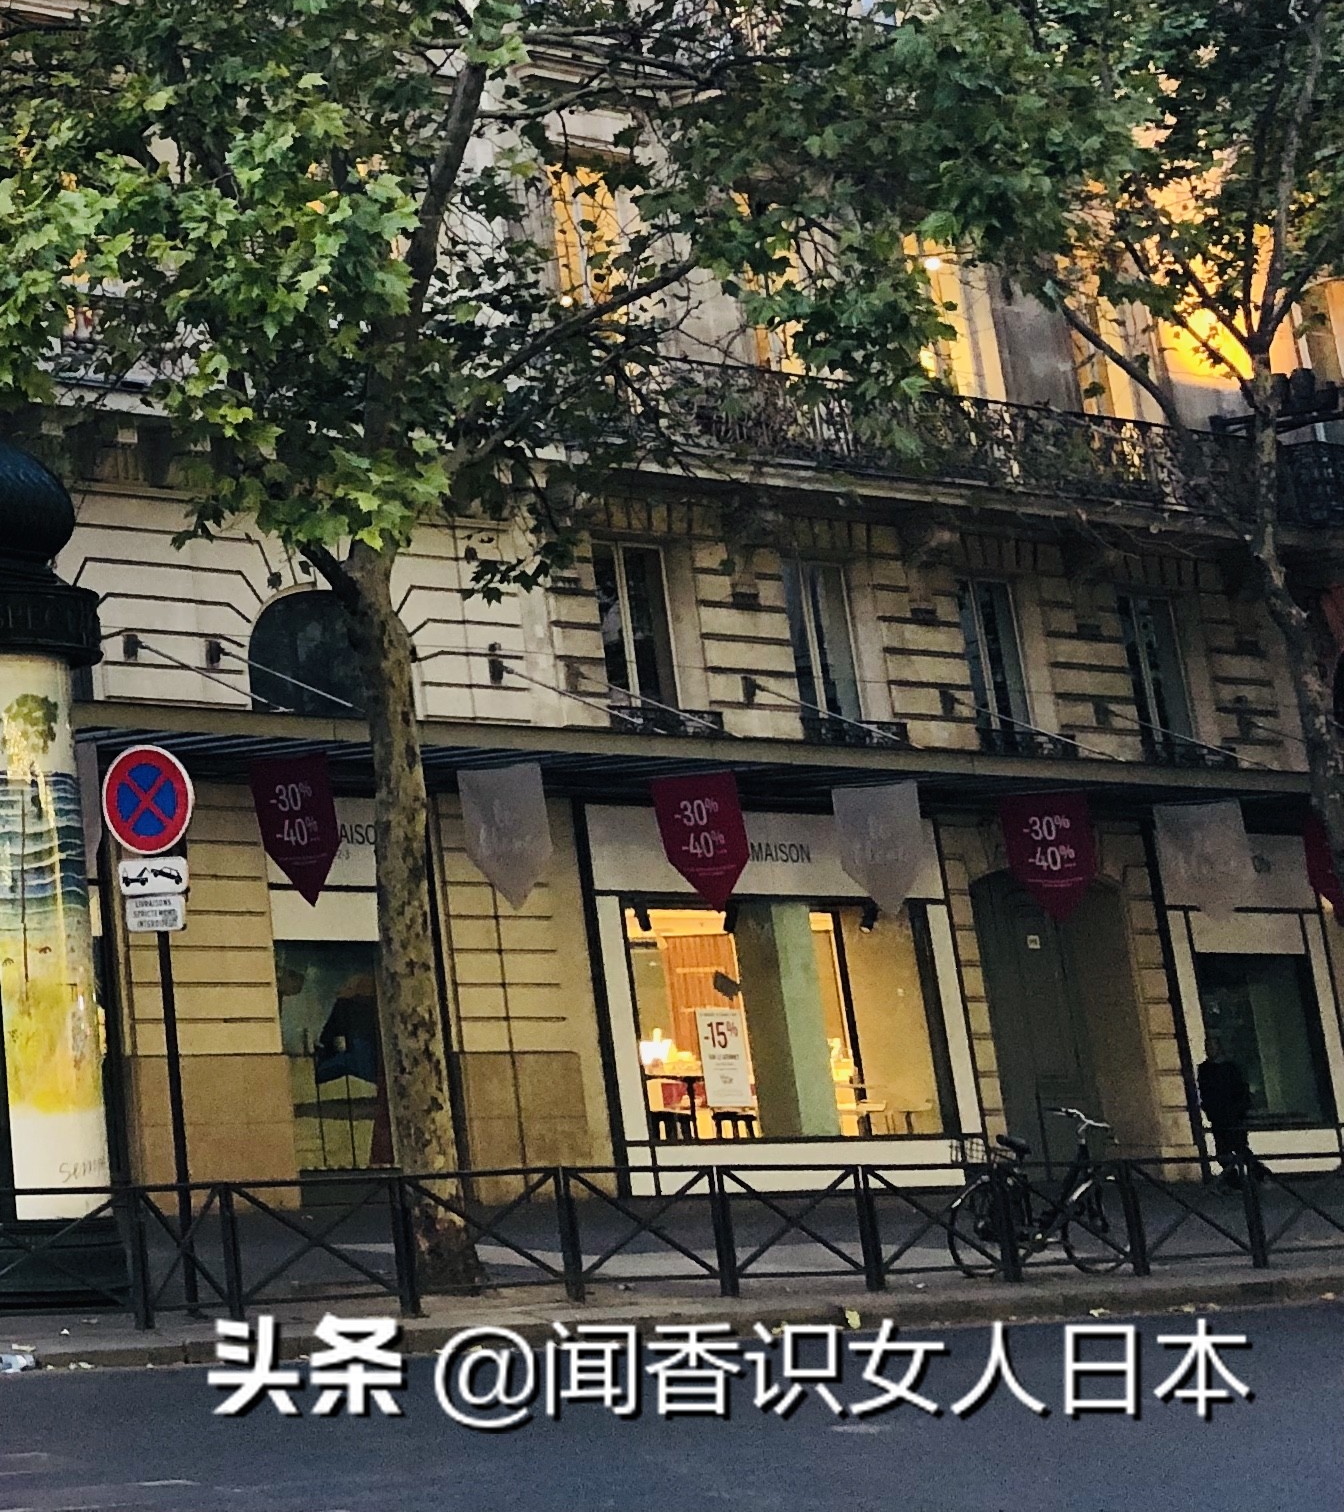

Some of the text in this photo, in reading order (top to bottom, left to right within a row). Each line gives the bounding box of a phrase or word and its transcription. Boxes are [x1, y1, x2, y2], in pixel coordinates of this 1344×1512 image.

[269, 782, 313, 812] -30%
[674, 797, 719, 827] -30%
[275, 816, 319, 846] -40%
[339, 823, 378, 845] AISO
[1023, 815, 1071, 840] -30%
[681, 831, 725, 858] -40%
[750, 841, 812, 863] MAISON
[1028, 845, 1076, 871] -40%
